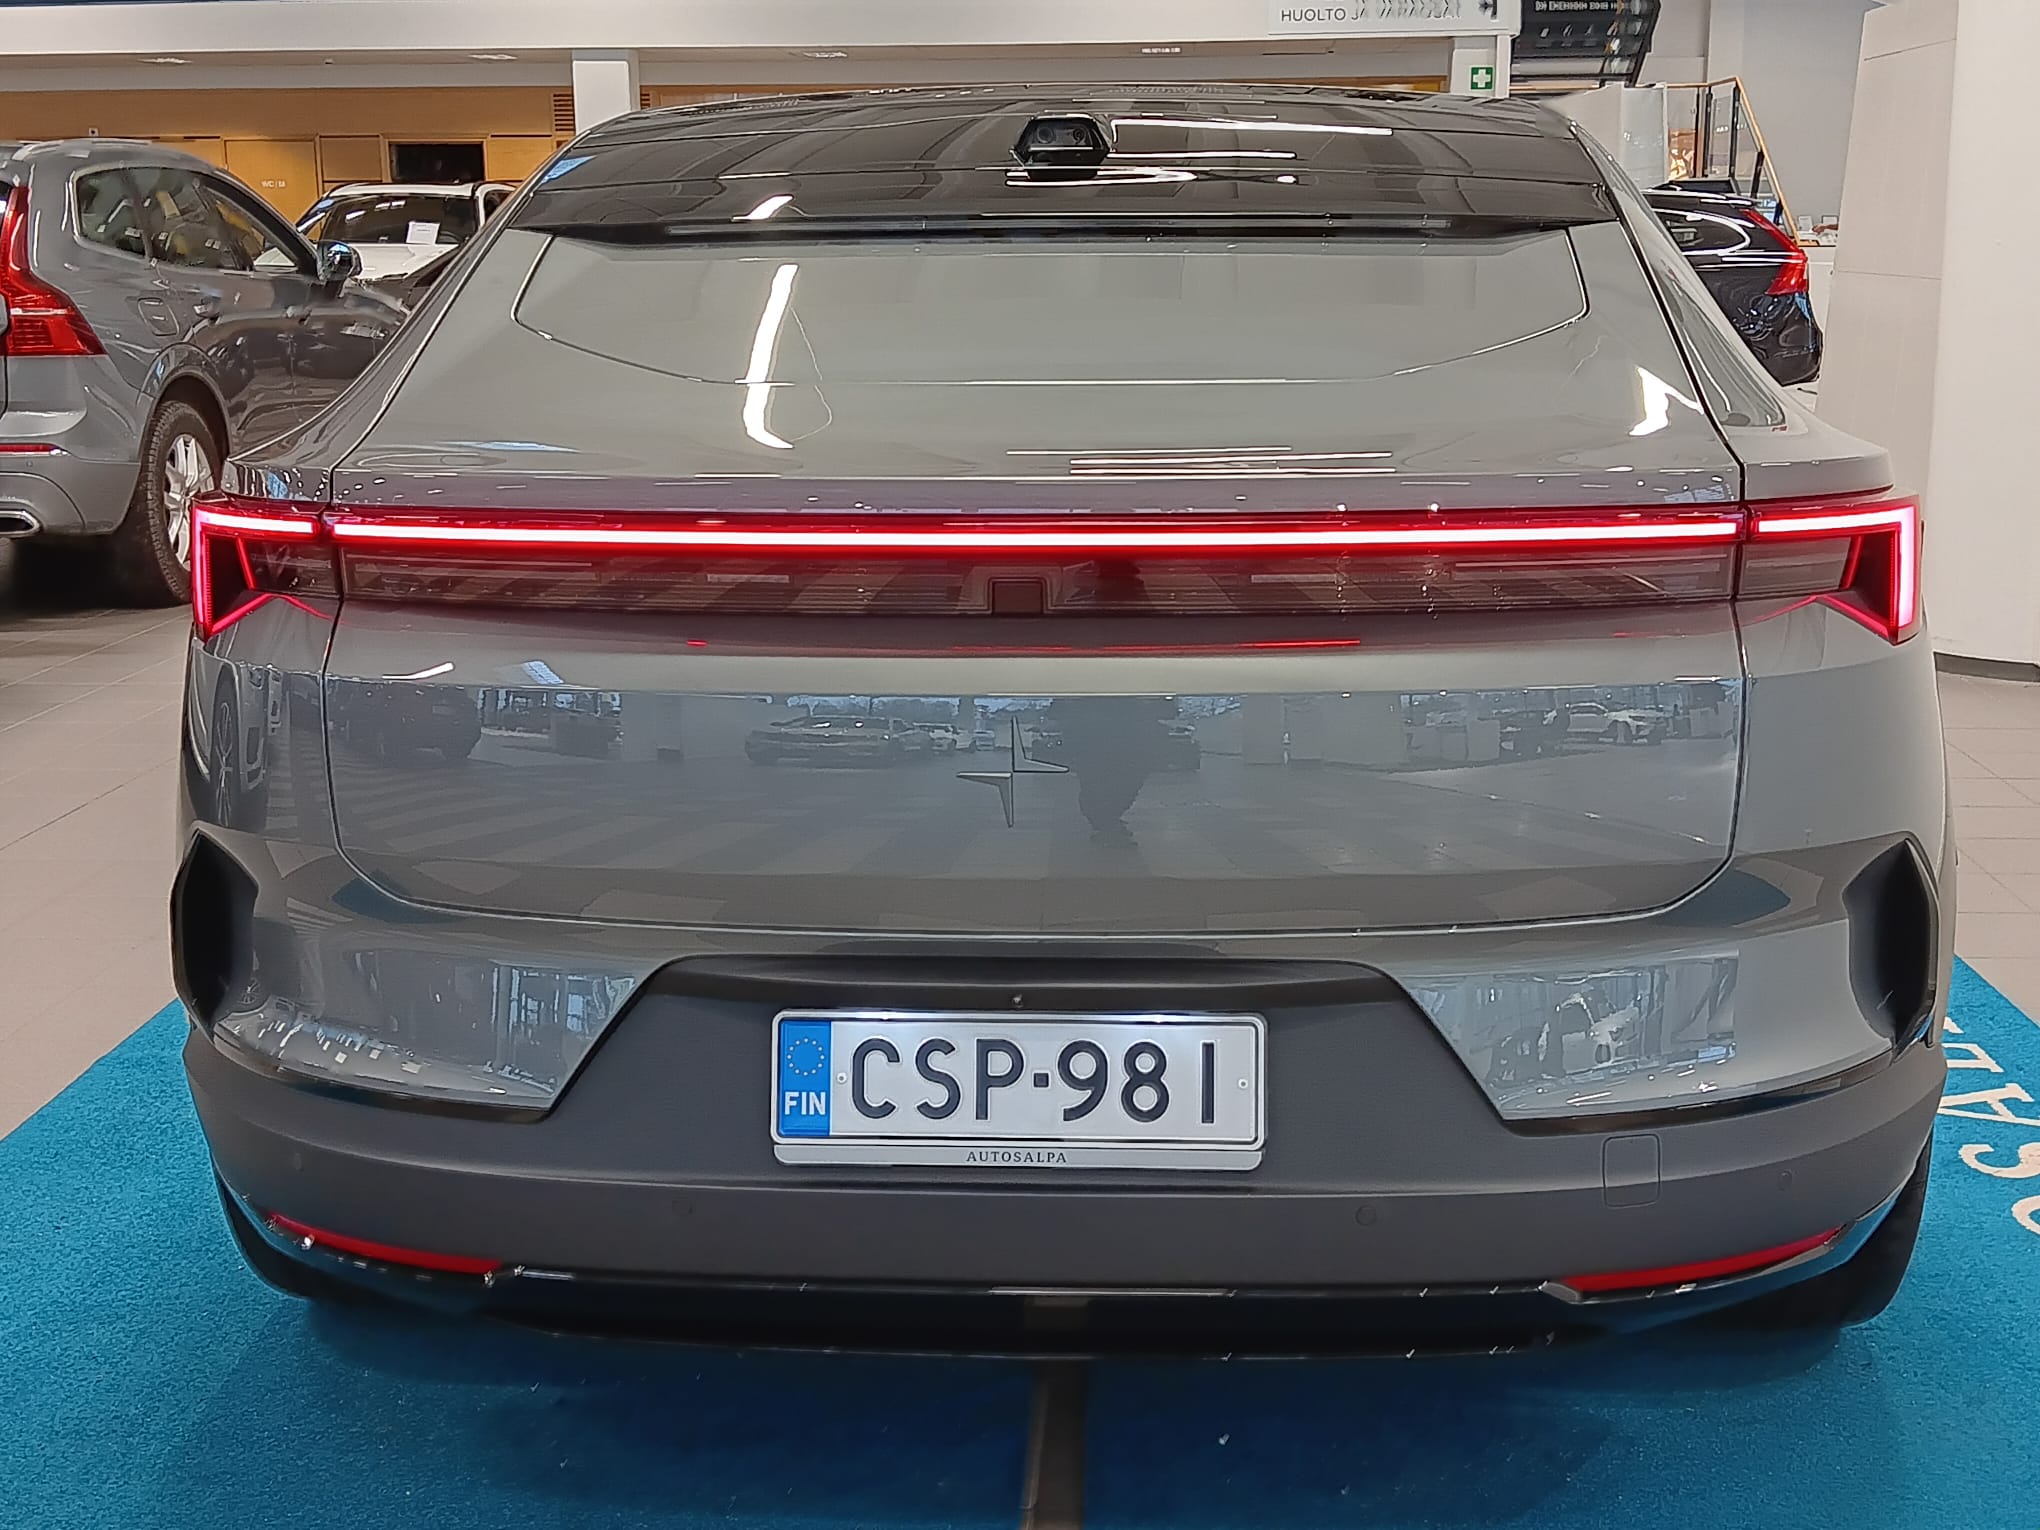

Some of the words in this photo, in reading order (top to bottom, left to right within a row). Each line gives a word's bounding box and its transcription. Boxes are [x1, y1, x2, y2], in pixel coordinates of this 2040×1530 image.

[1281, 8, 1346, 22] HUOLTO
[850, 1036, 1218, 1125] CSP-981
[784, 1091, 826, 1116] FIN
[966, 1150, 1068, 1165] AUTOSALPA
